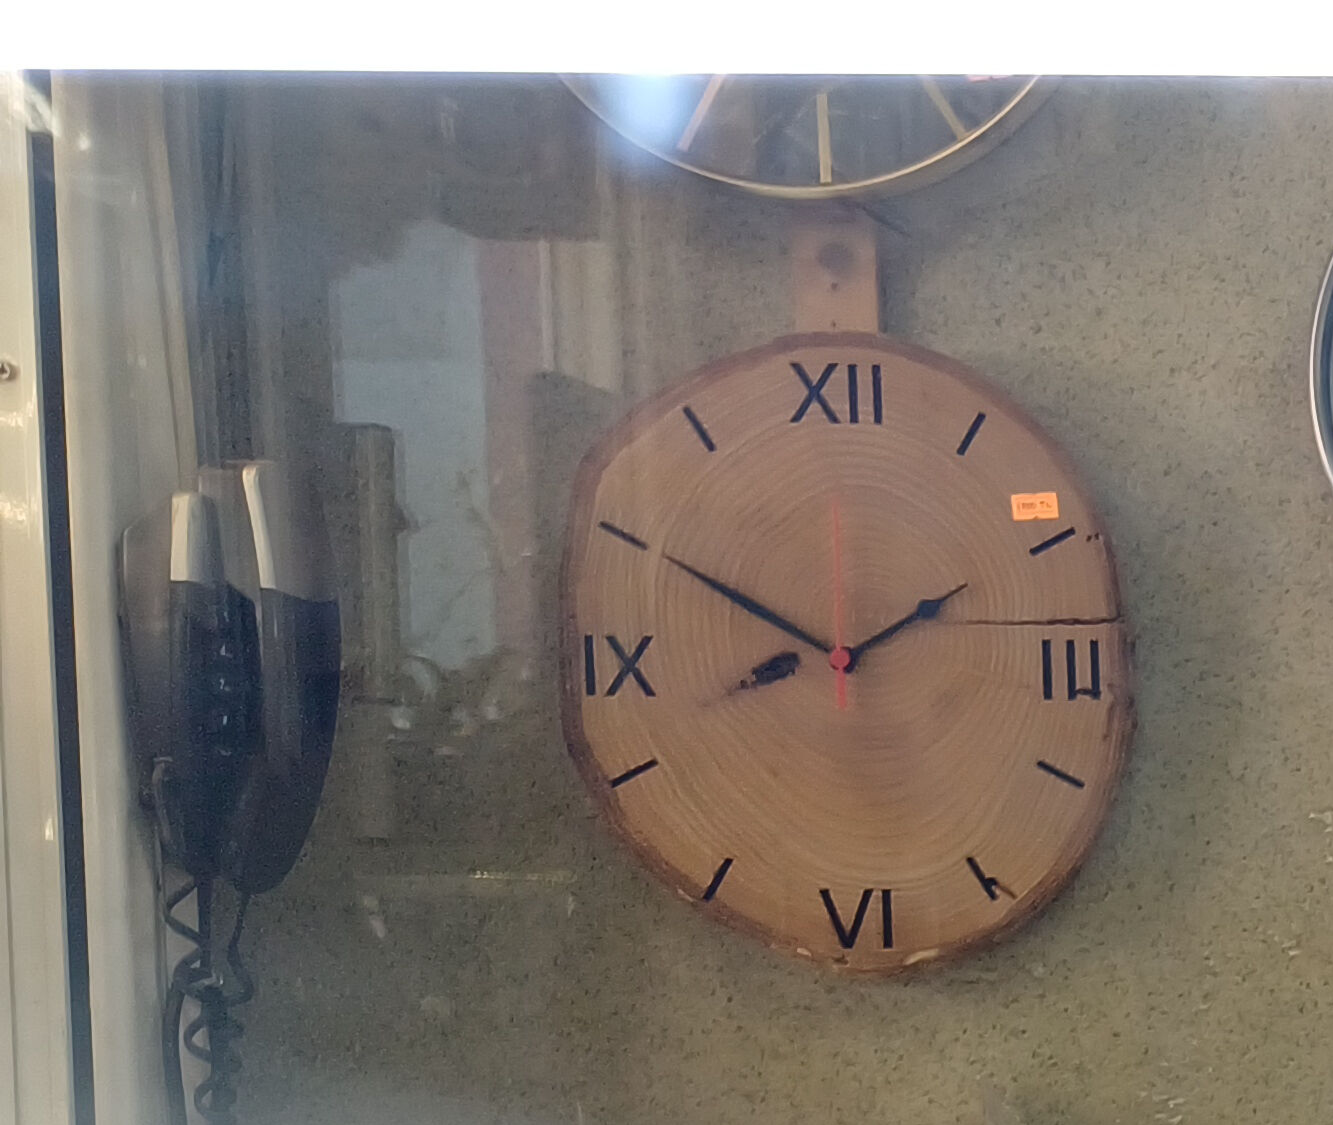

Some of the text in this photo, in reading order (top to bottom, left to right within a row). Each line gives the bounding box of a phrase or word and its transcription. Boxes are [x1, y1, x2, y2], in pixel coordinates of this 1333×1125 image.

[789, 362, 883, 425] XII
[583, 635, 656, 697] IX
[1041, 639, 1100, 700] III
[818, 888, 894, 949] VI
